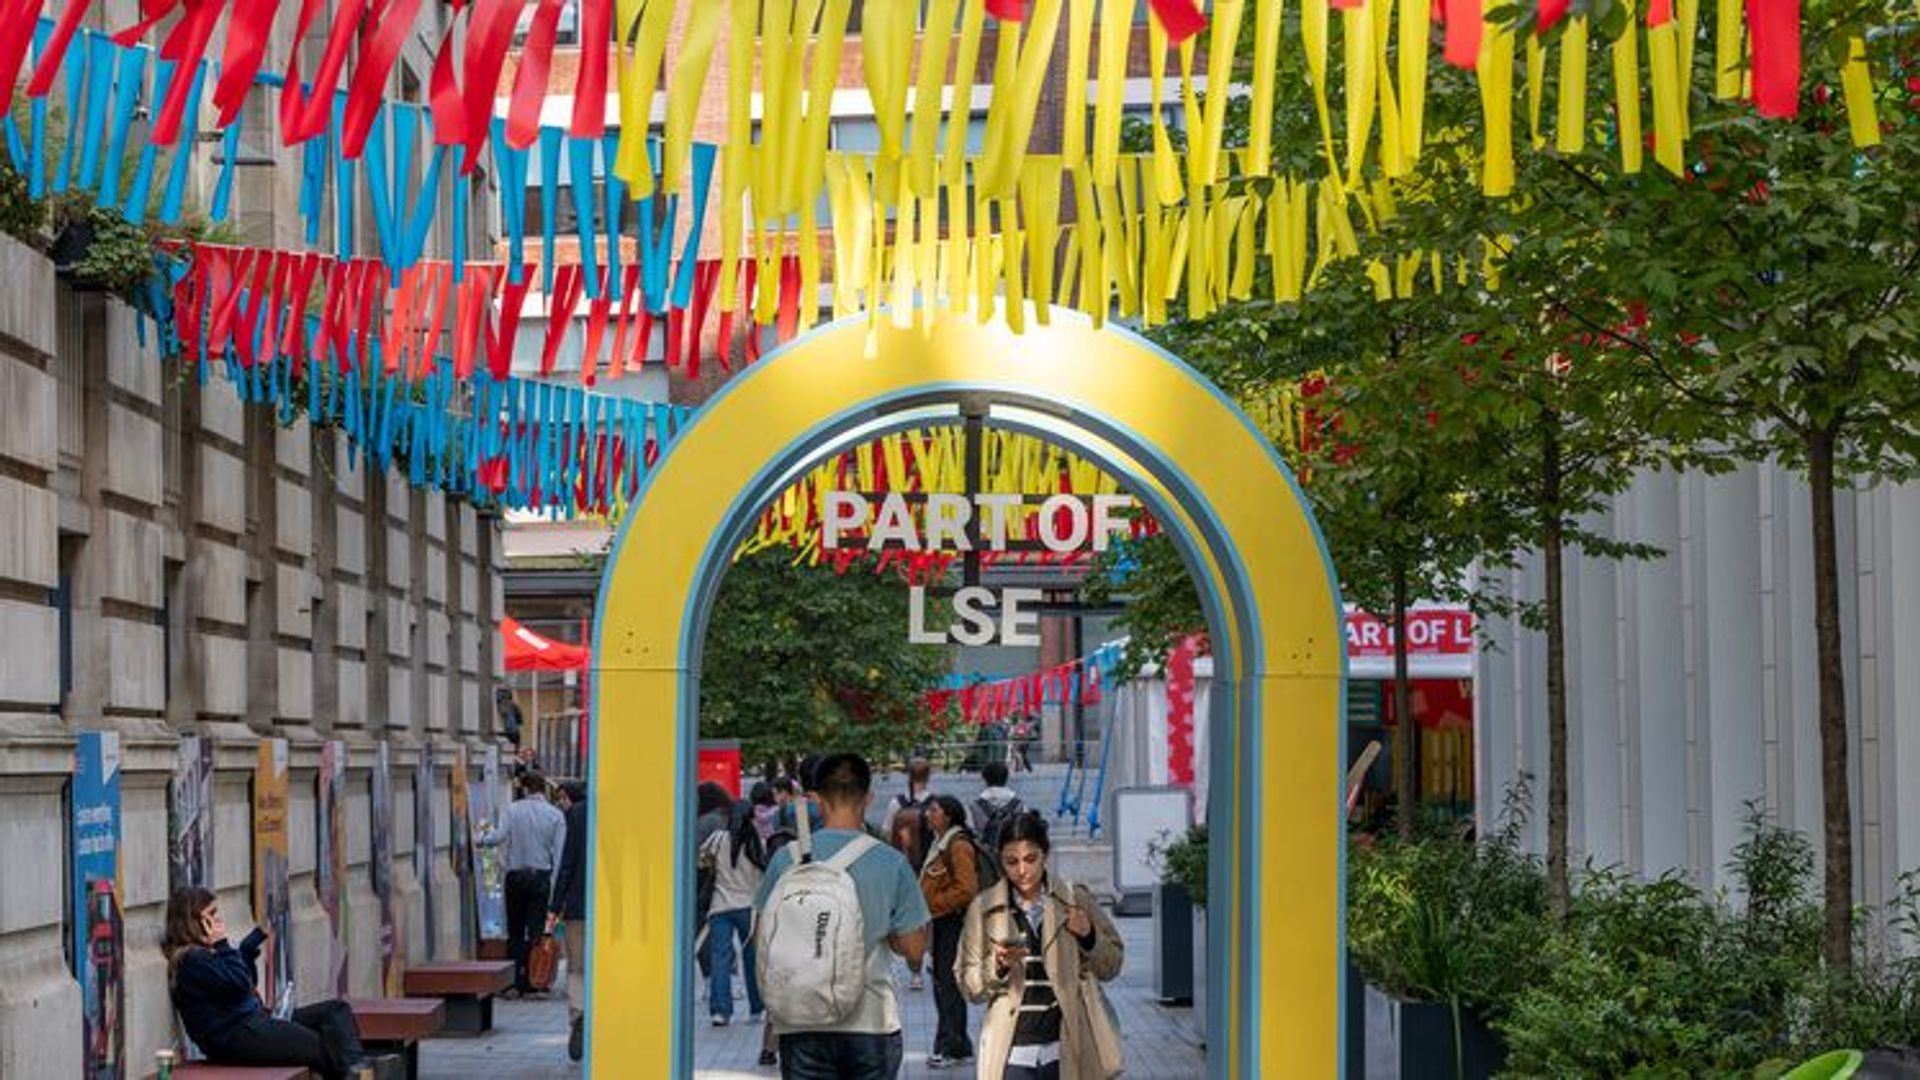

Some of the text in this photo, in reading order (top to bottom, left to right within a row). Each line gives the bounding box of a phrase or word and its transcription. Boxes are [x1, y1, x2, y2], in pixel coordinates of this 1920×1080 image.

[823, 491, 1132, 551] PART OF
[909, 587, 1042, 647] LSE
[1408, 619, 1446, 644] OF
